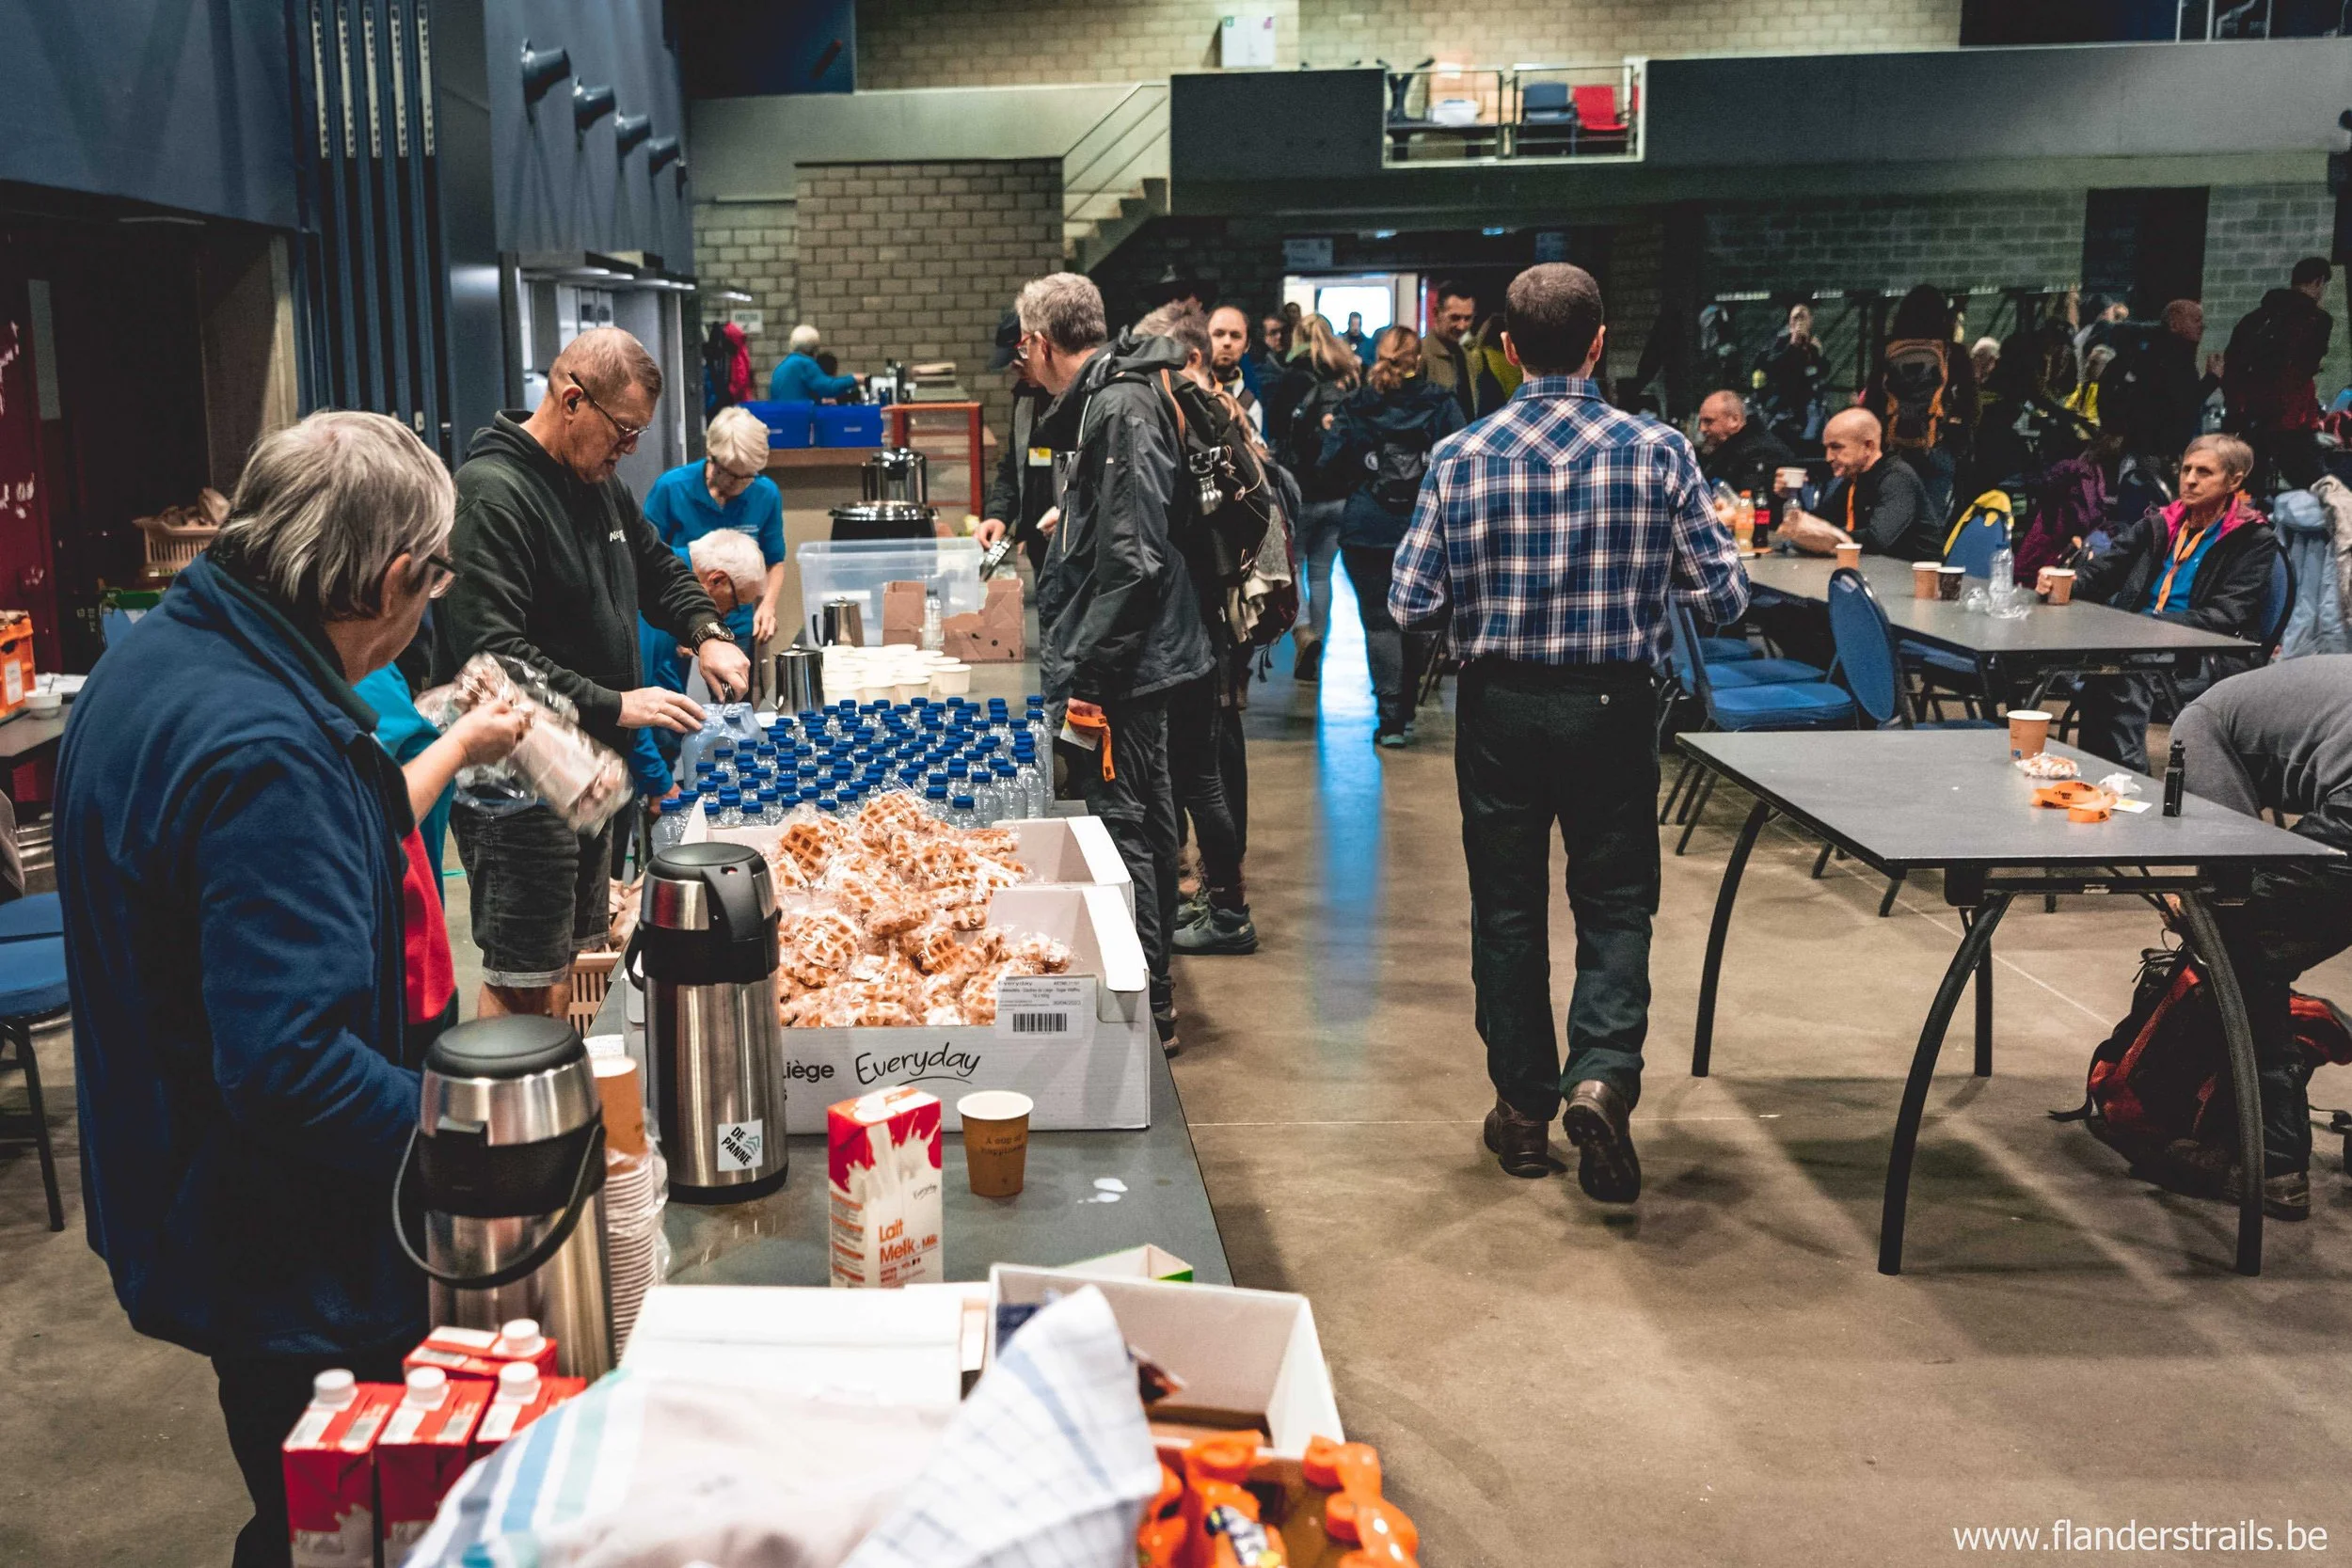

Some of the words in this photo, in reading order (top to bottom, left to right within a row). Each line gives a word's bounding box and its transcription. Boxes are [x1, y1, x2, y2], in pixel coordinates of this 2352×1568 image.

[783, 1059, 835, 1084] iège
[855, 1041, 981, 1085] Everyday
[730, 1126, 747, 1142] DE
[985, 1136, 993, 1145] A
[994, 1136, 1012, 1145] cup
[1014, 1132, 1023, 1142] of
[721, 1136, 753, 1166] PANNE
[879, 1217, 903, 1243] Lait
[880, 1237, 915, 1264] Melk
